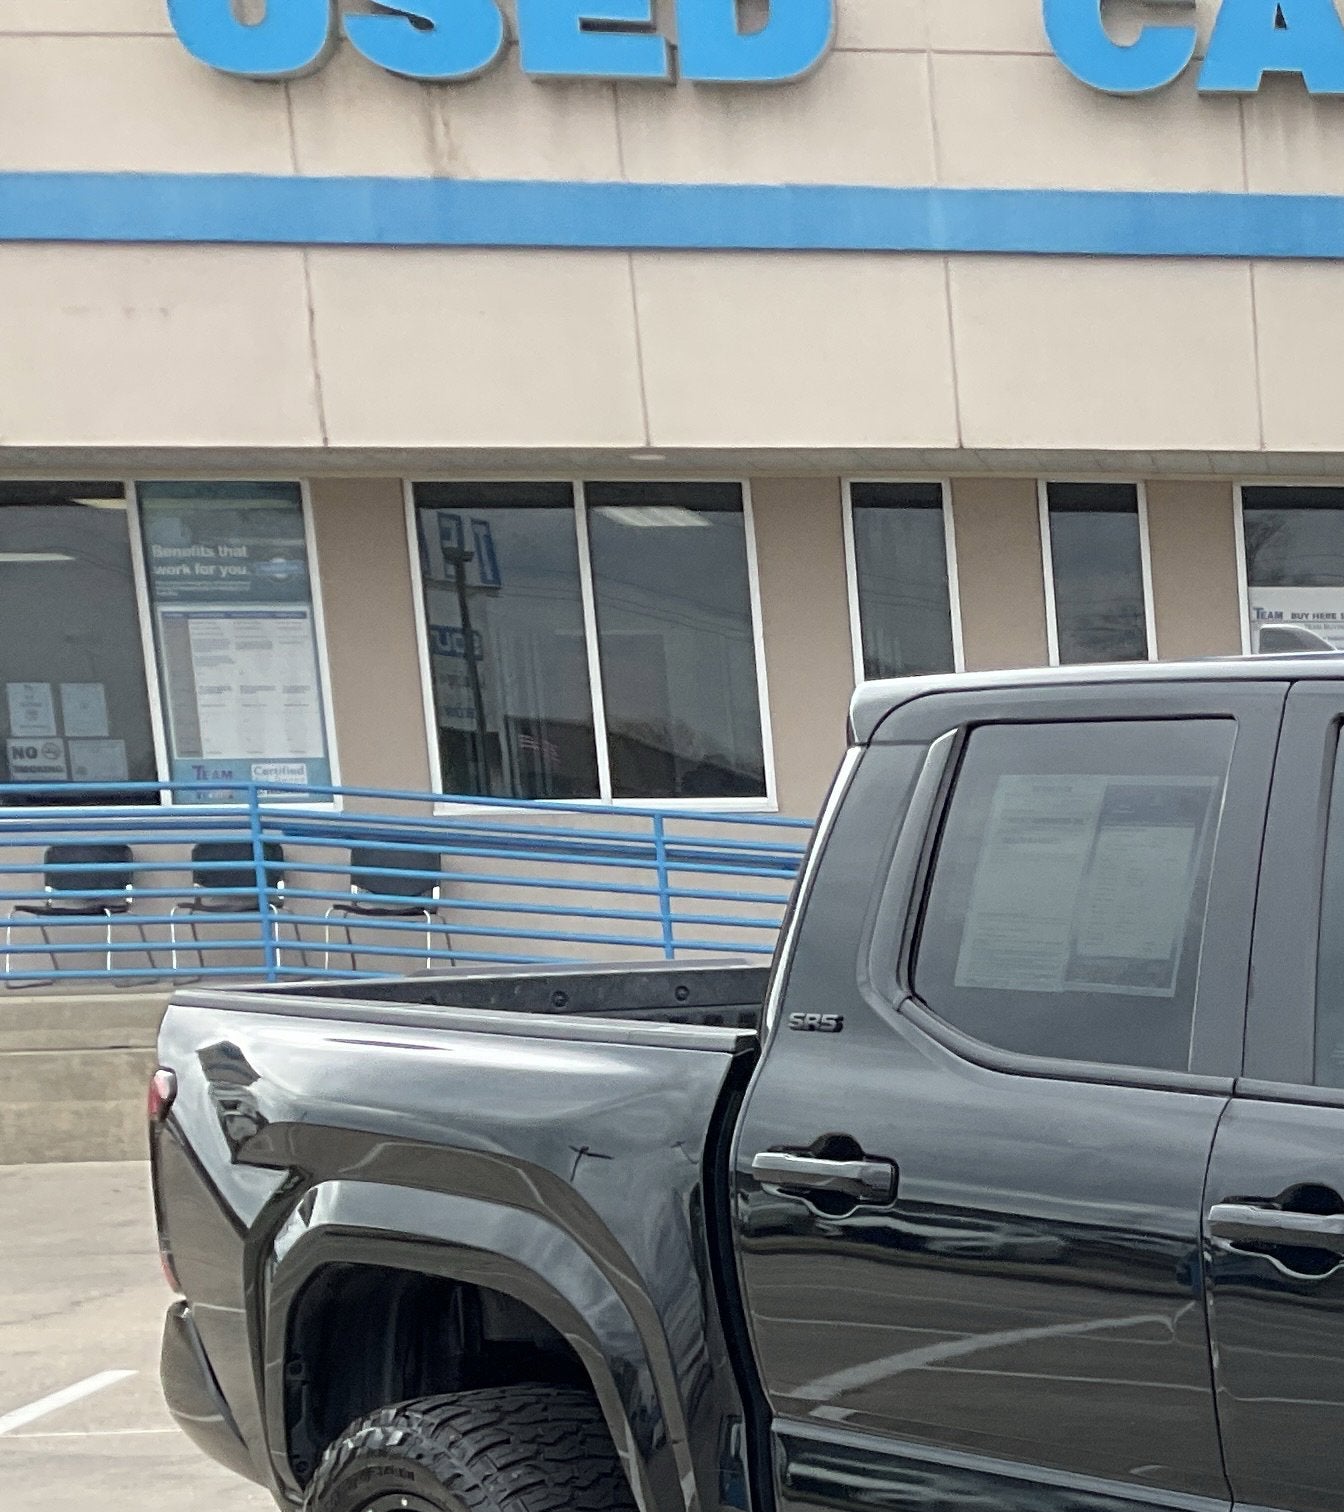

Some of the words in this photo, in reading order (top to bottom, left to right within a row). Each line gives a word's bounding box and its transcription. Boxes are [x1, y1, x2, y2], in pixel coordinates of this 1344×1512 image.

[194, 563, 214, 575] for
[1291, 612, 1309, 620] BUY
[1312, 612, 1337, 620] HERE
[11, 746, 38, 759] NO
[192, 765, 233, 780] TEAM
[787, 1012, 843, 1032] SR5
